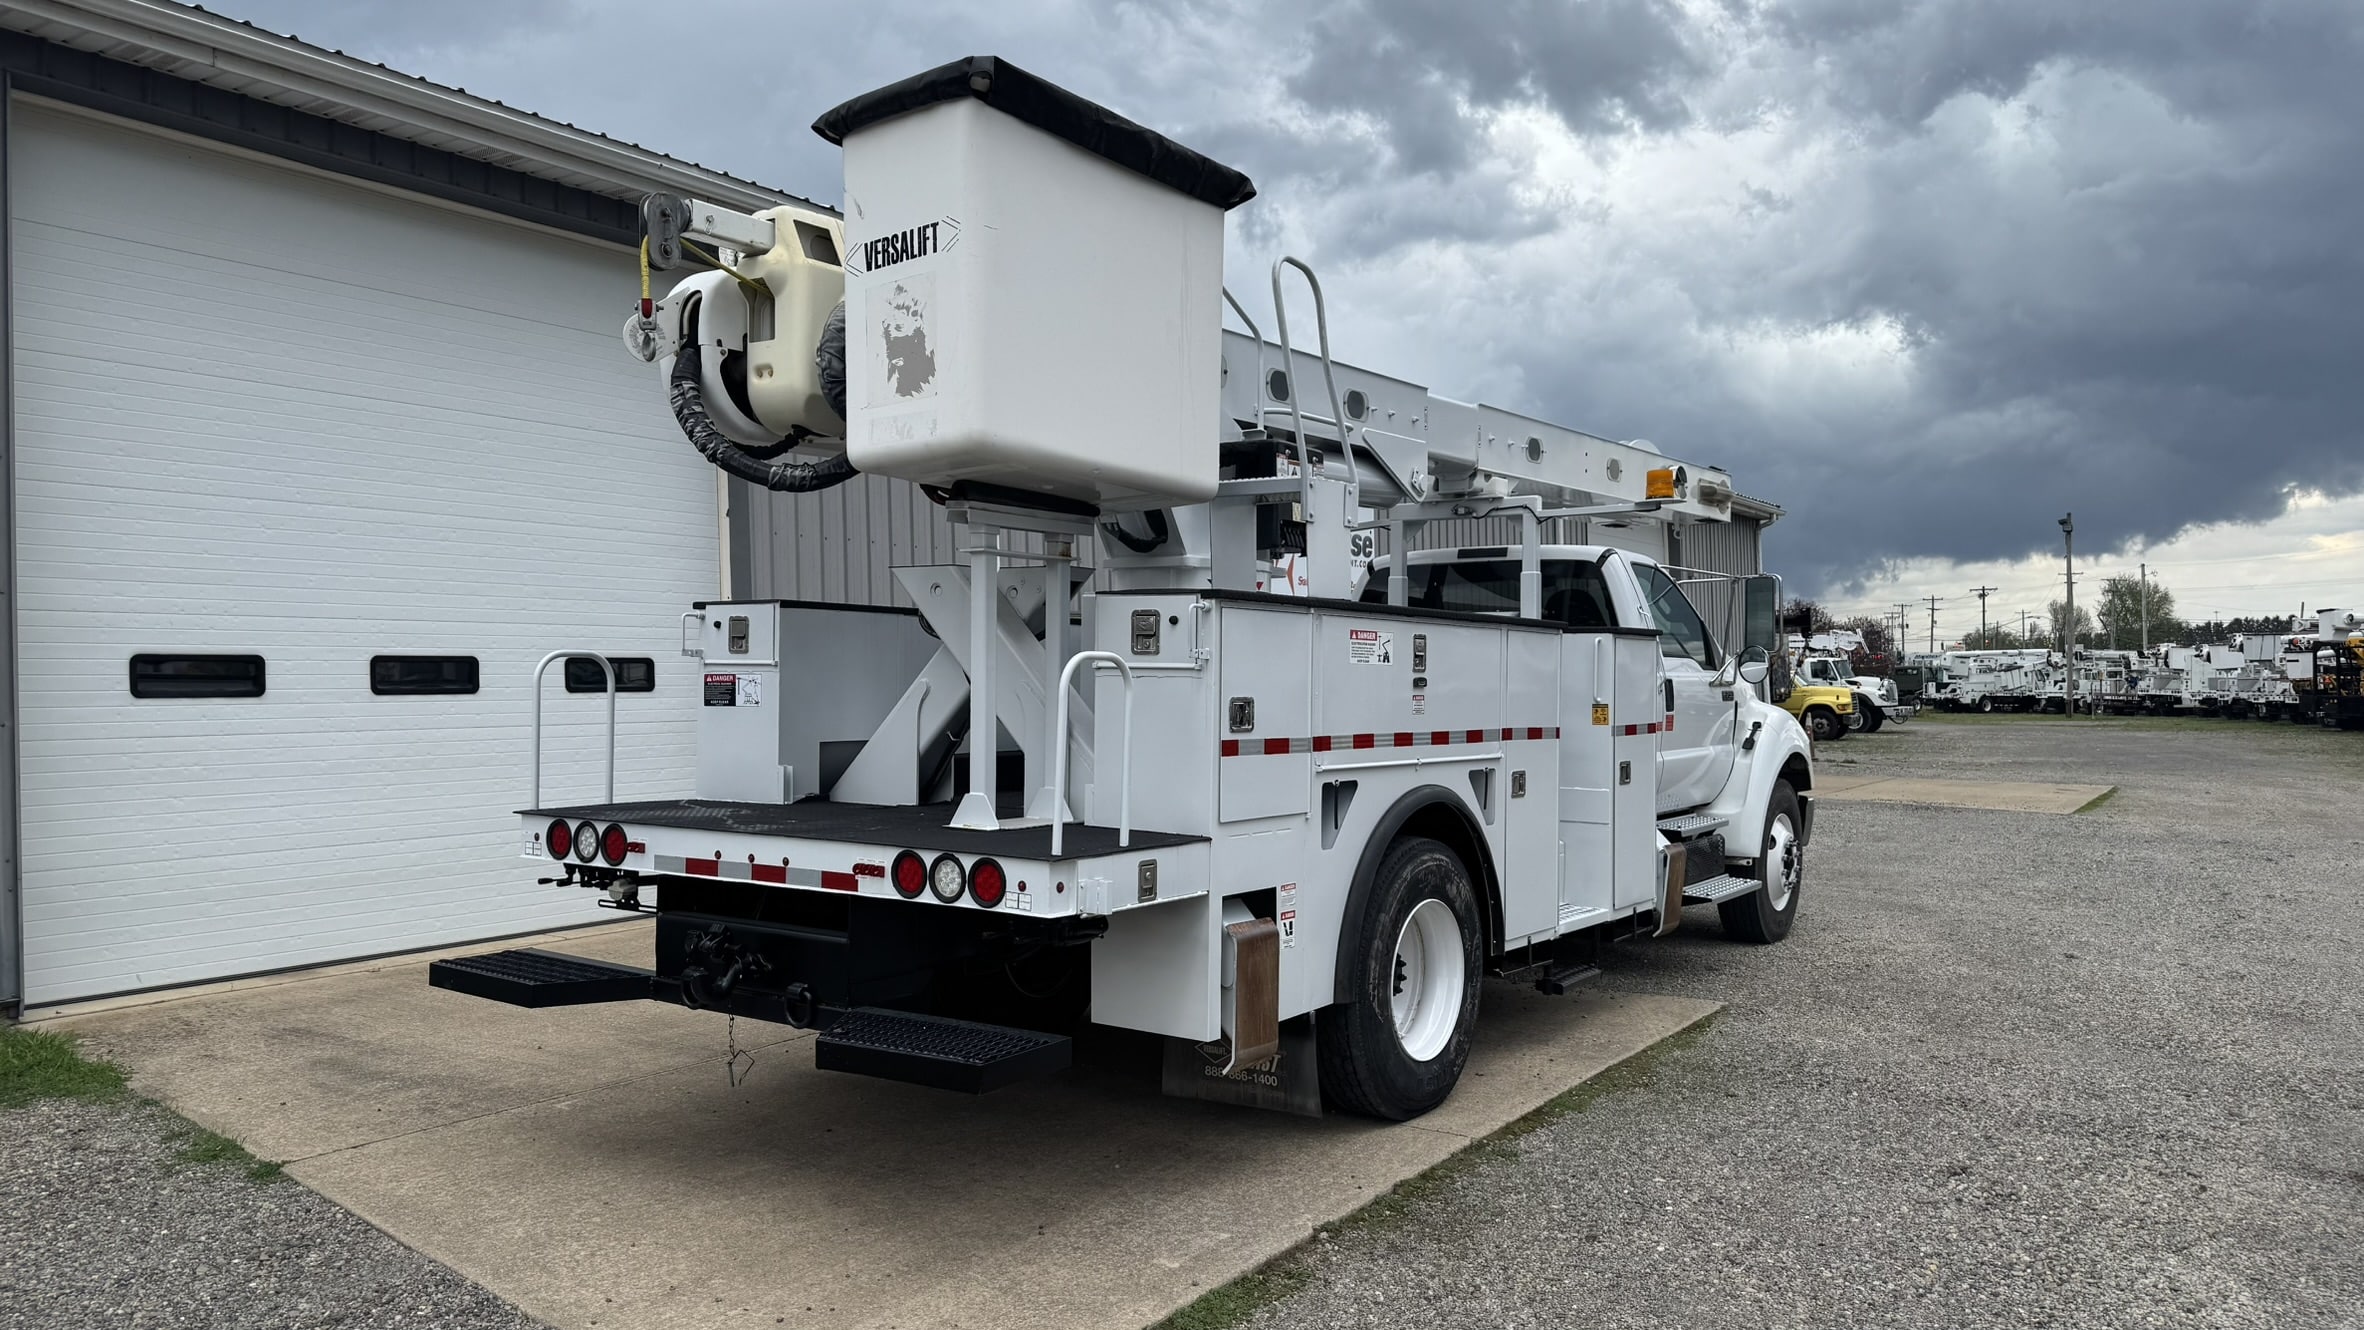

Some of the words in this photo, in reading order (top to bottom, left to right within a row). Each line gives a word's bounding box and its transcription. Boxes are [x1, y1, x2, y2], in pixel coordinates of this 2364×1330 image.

[863, 221, 940, 272] VERSALIFT
[1350, 533, 1373, 558] se
[1357, 631, 1376, 640] DANGER
